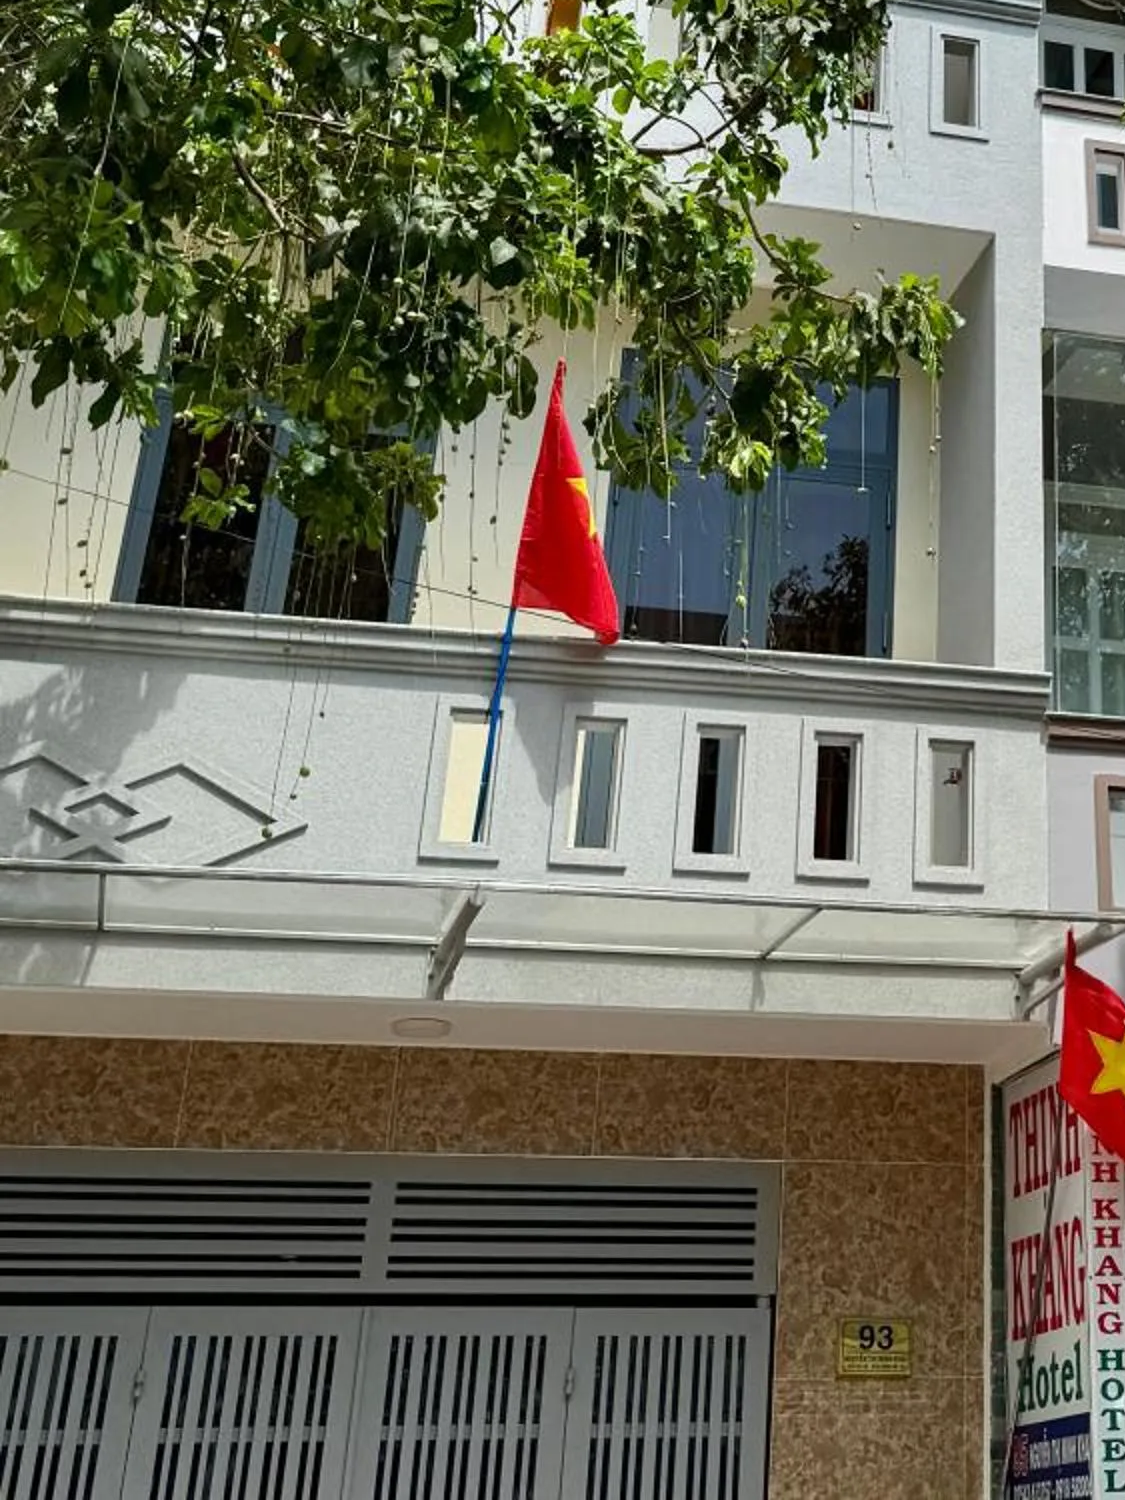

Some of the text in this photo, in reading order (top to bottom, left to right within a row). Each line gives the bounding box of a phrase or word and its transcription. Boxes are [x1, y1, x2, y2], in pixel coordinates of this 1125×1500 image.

[1011, 1216, 1086, 1342] KHANG
[1092, 1198, 1125, 1335] KHANG
[859, 1324, 894, 1350] 93
[1016, 1339, 1084, 1413] Hotel
